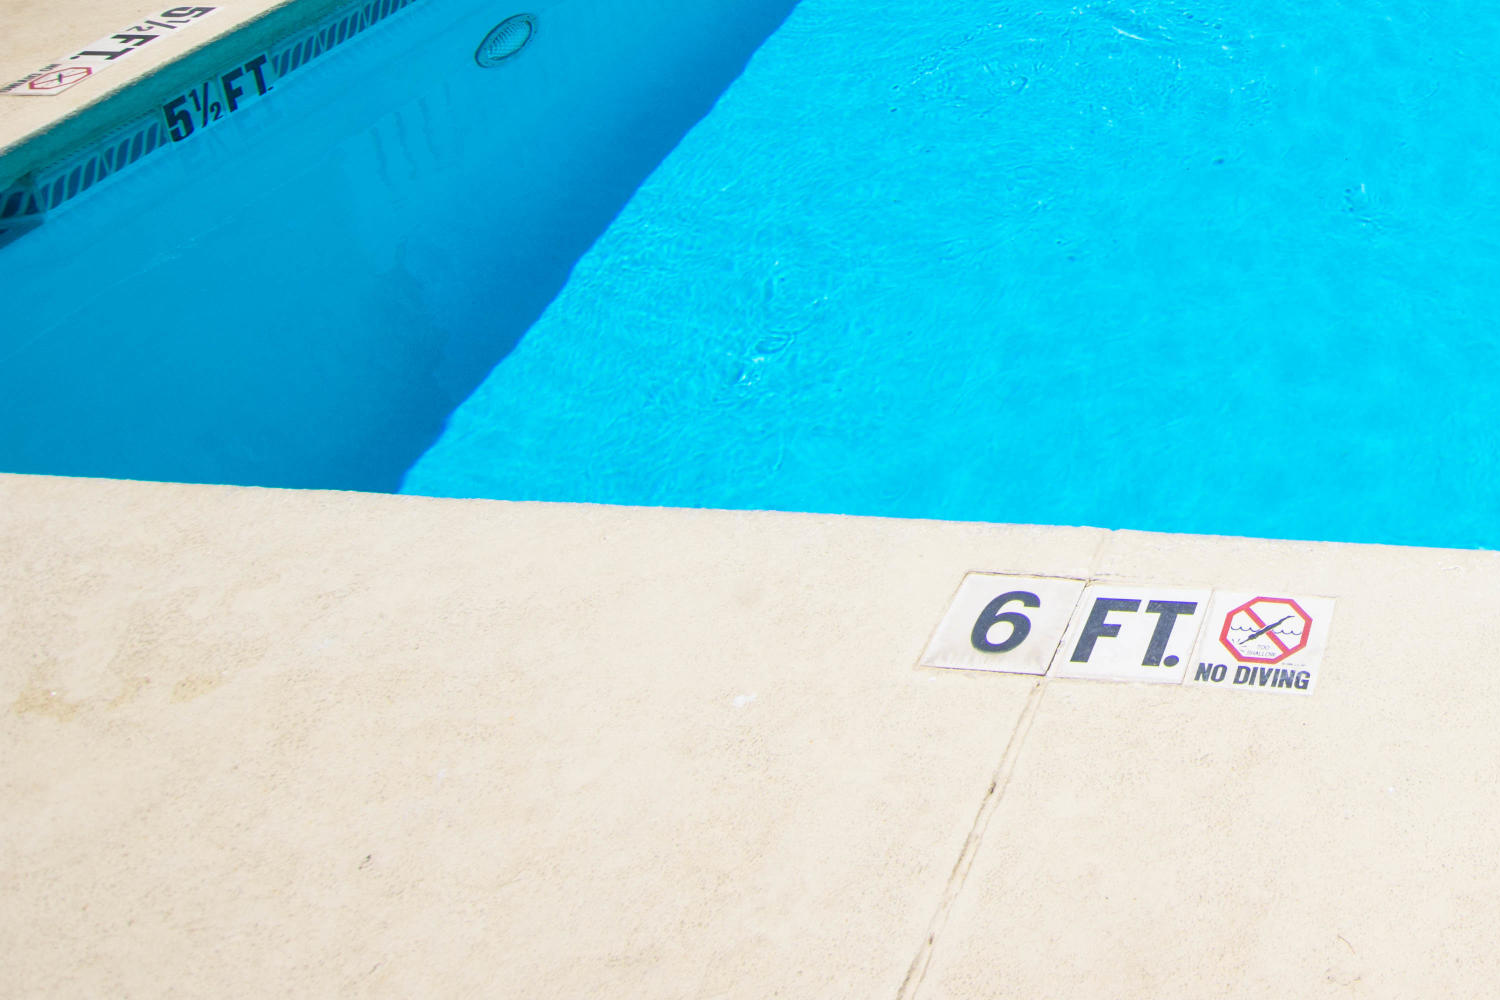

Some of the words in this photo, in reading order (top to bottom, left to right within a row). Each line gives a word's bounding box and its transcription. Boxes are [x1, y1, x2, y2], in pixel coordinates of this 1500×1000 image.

[970, 590, 1041, 654] 6
[1070, 597, 1198, 668] FT.
[1194, 662, 1228, 682] NO
[1232, 665, 1310, 690] DIVING
